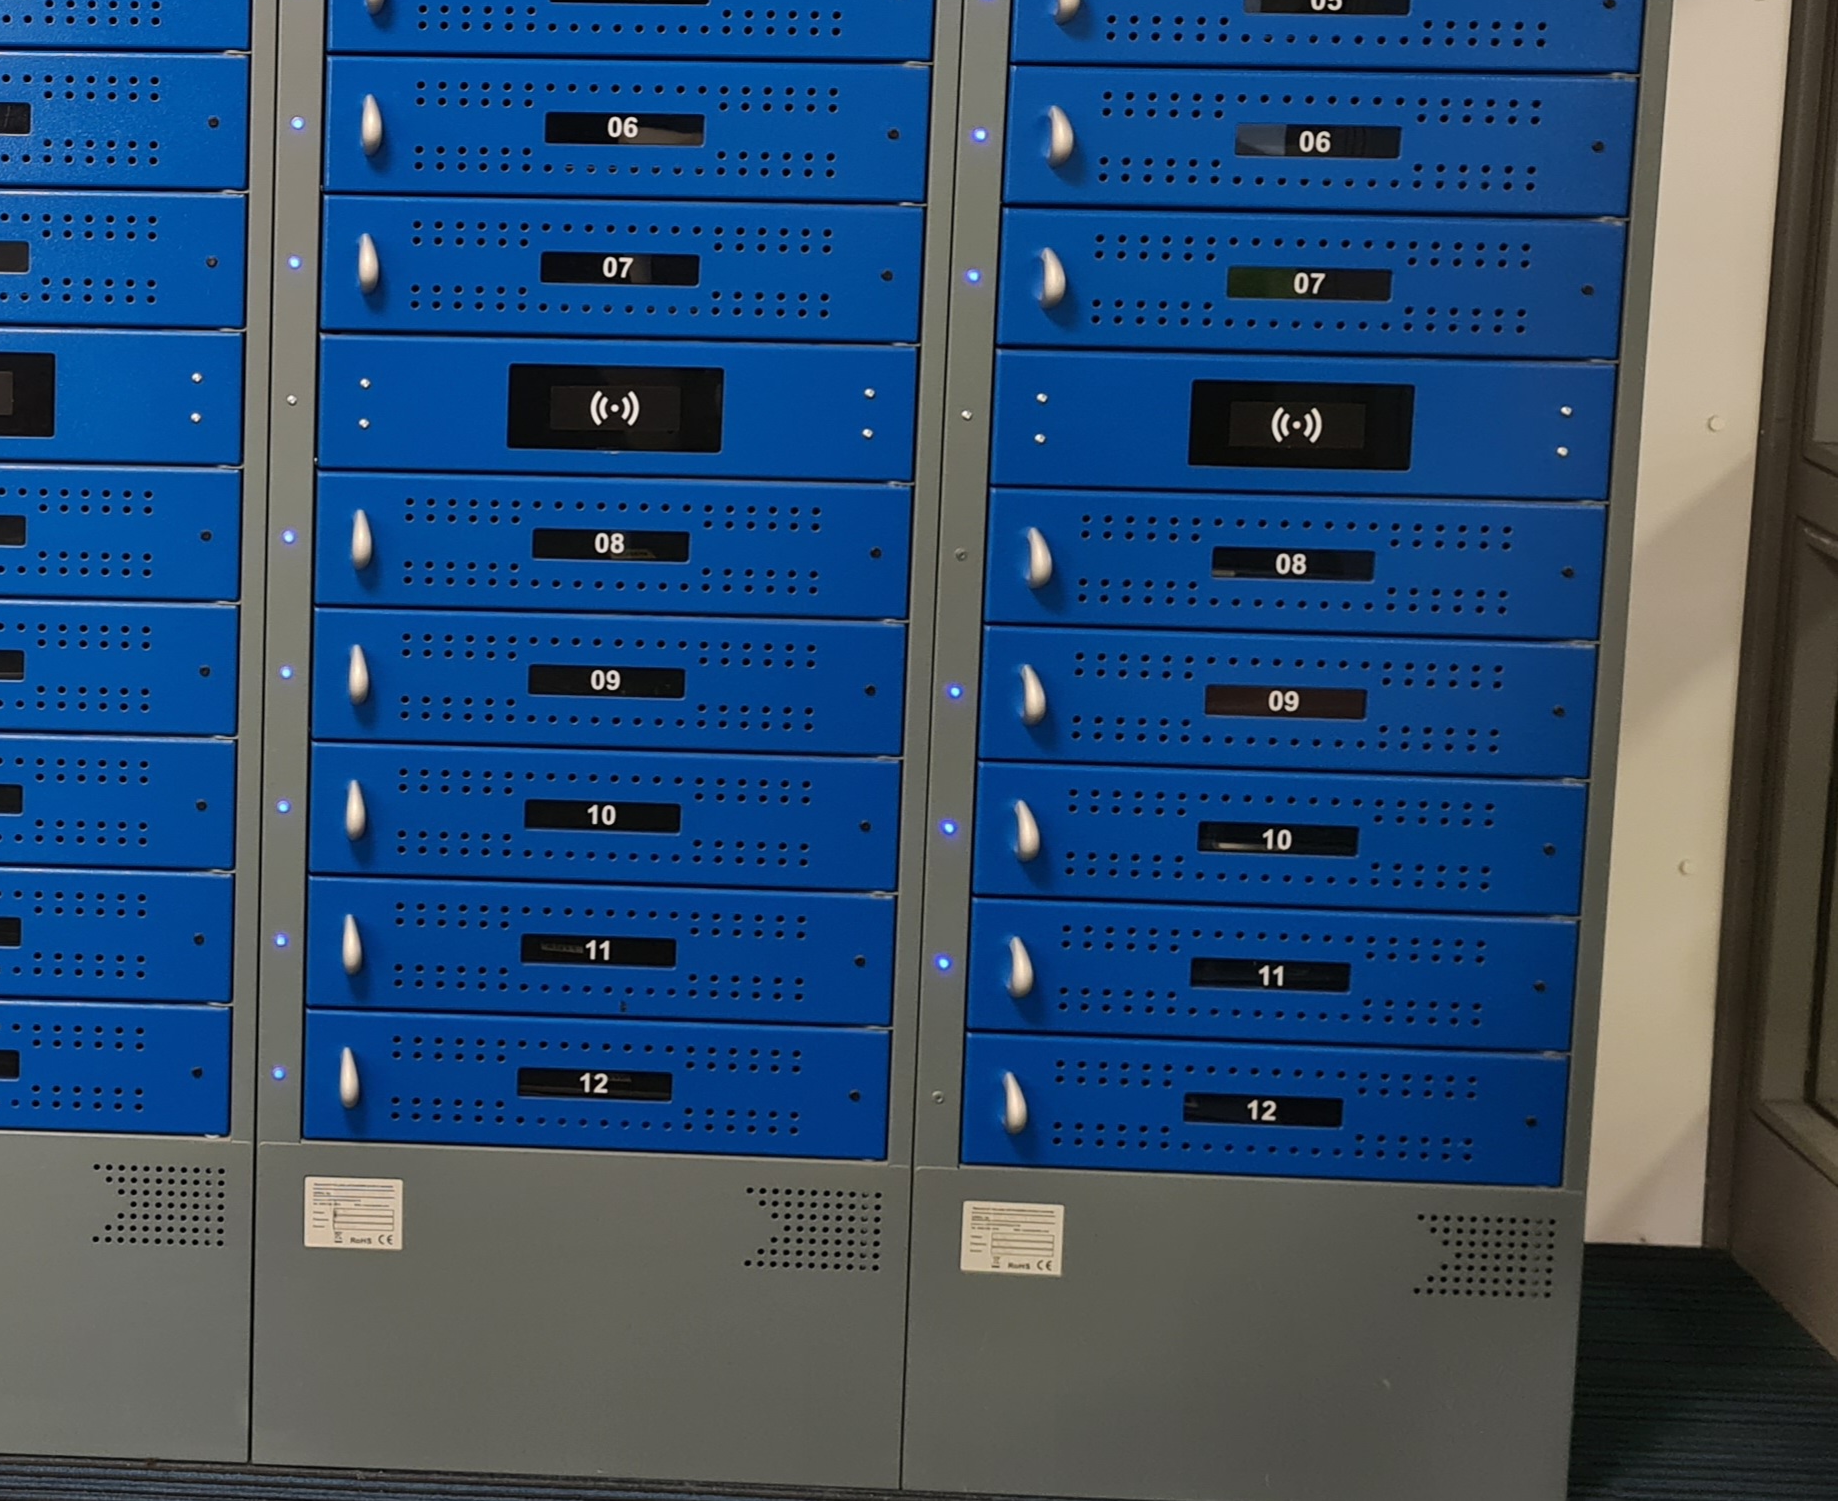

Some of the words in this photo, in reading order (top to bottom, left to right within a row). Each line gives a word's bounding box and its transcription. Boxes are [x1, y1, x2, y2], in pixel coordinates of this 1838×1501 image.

[608, 117, 637, 137] 06
[1300, 131, 1330, 152] 06
[603, 257, 633, 277] 07
[1295, 273, 1325, 293] 07
[595, 533, 624, 553] 08
[1276, 554, 1306, 574] 08
[591, 670, 620, 690] 09
[1269, 691, 1299, 711] 09
[588, 805, 615, 825] 10
[1263, 829, 1291, 850] 10
[586, 940, 609, 960] 11
[1259, 966, 1283, 986] 11
[580, 1073, 607, 1093] 12
[1248, 1100, 1276, 1120] 12
